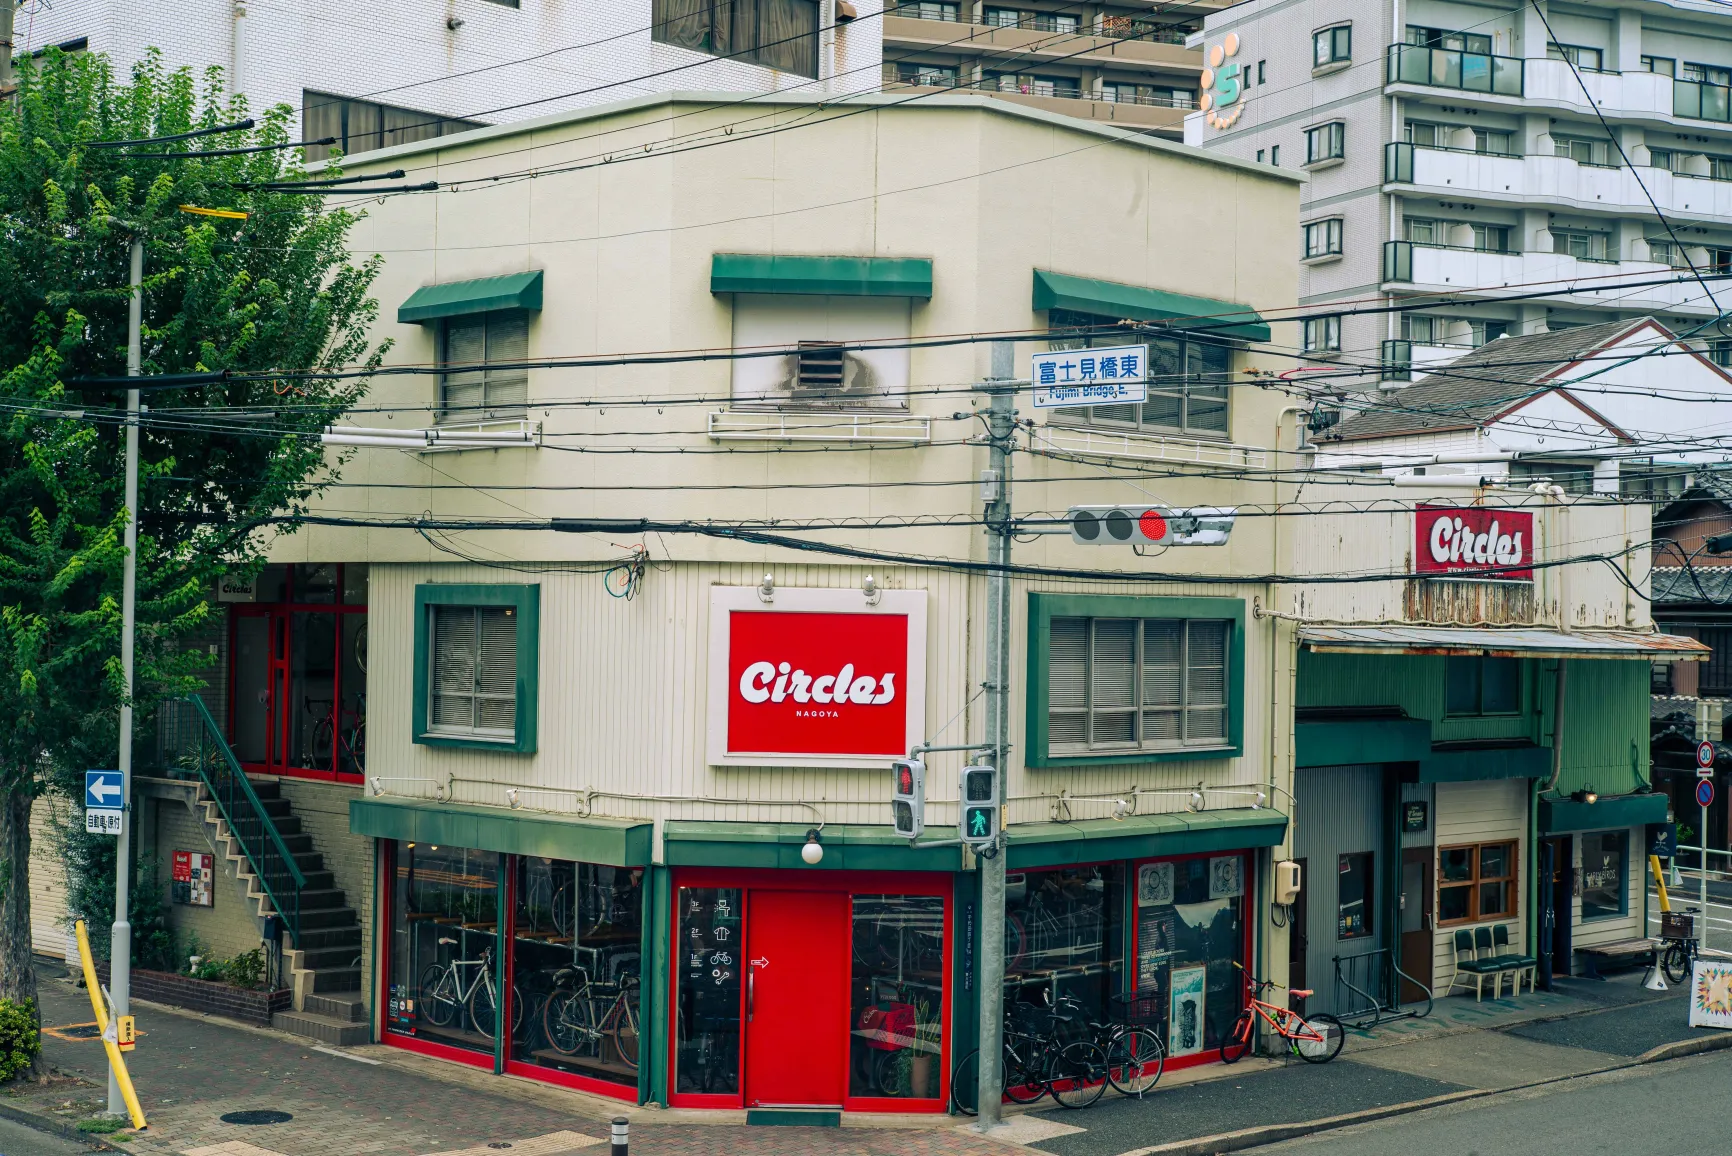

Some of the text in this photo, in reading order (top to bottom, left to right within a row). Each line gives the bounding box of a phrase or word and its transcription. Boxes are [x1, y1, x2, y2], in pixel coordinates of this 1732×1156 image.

[1039, 354, 1139, 384] 富士見橋東
[1049, 386, 1080, 401] Fujimi
[1082, 383, 1115, 398] Bridge
[1430, 515, 1523, 565] Circles
[739, 661, 896, 705] Circles
[795, 710, 839, 718] NAGOYA
[1701, 748, 1711, 761] 30
